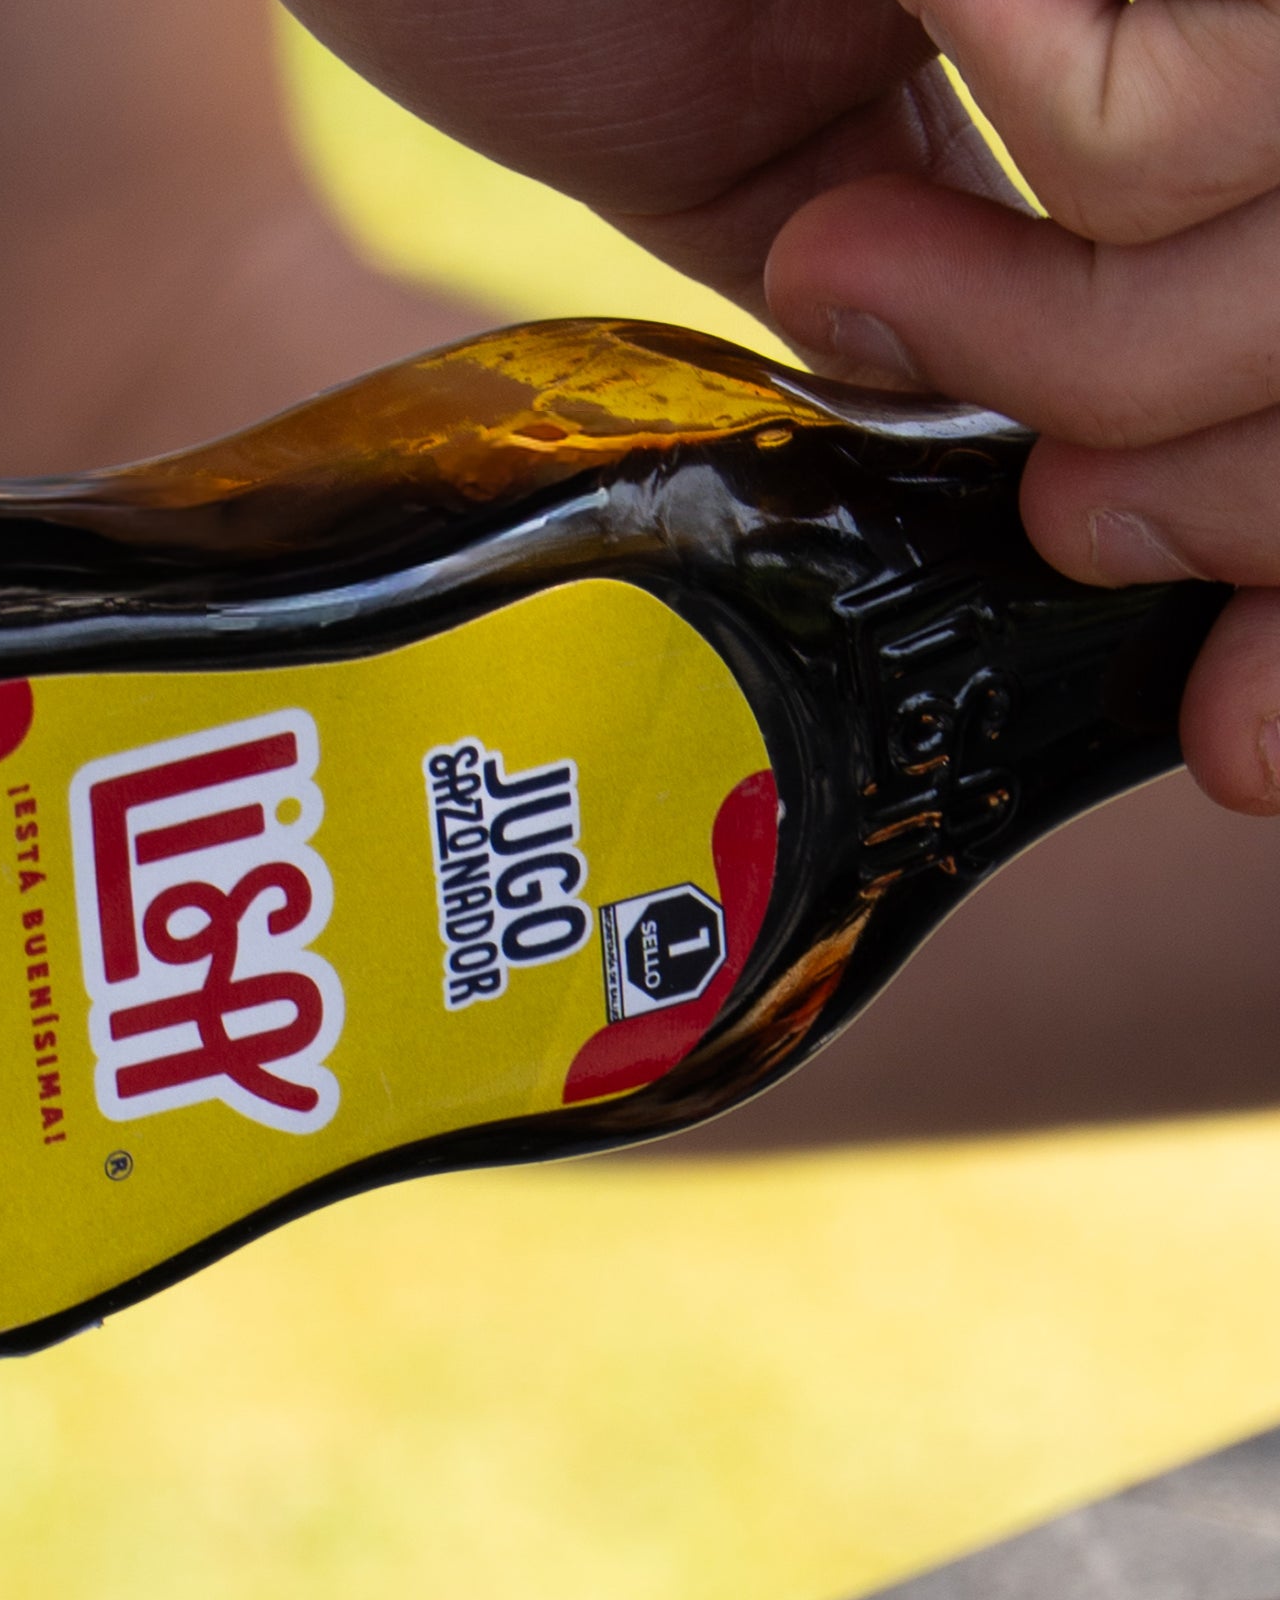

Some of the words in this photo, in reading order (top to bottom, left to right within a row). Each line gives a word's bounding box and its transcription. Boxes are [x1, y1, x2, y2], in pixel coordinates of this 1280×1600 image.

[7, 782, 47, 894] ¡ESTÁ
[429, 745, 501, 1005] SAZONADOR
[483, 759, 587, 962] JUGO
[640, 919, 662, 990] SELLO
[667, 926, 711, 958] 1
[21, 908, 66, 1146] BUENÍSIMA!
